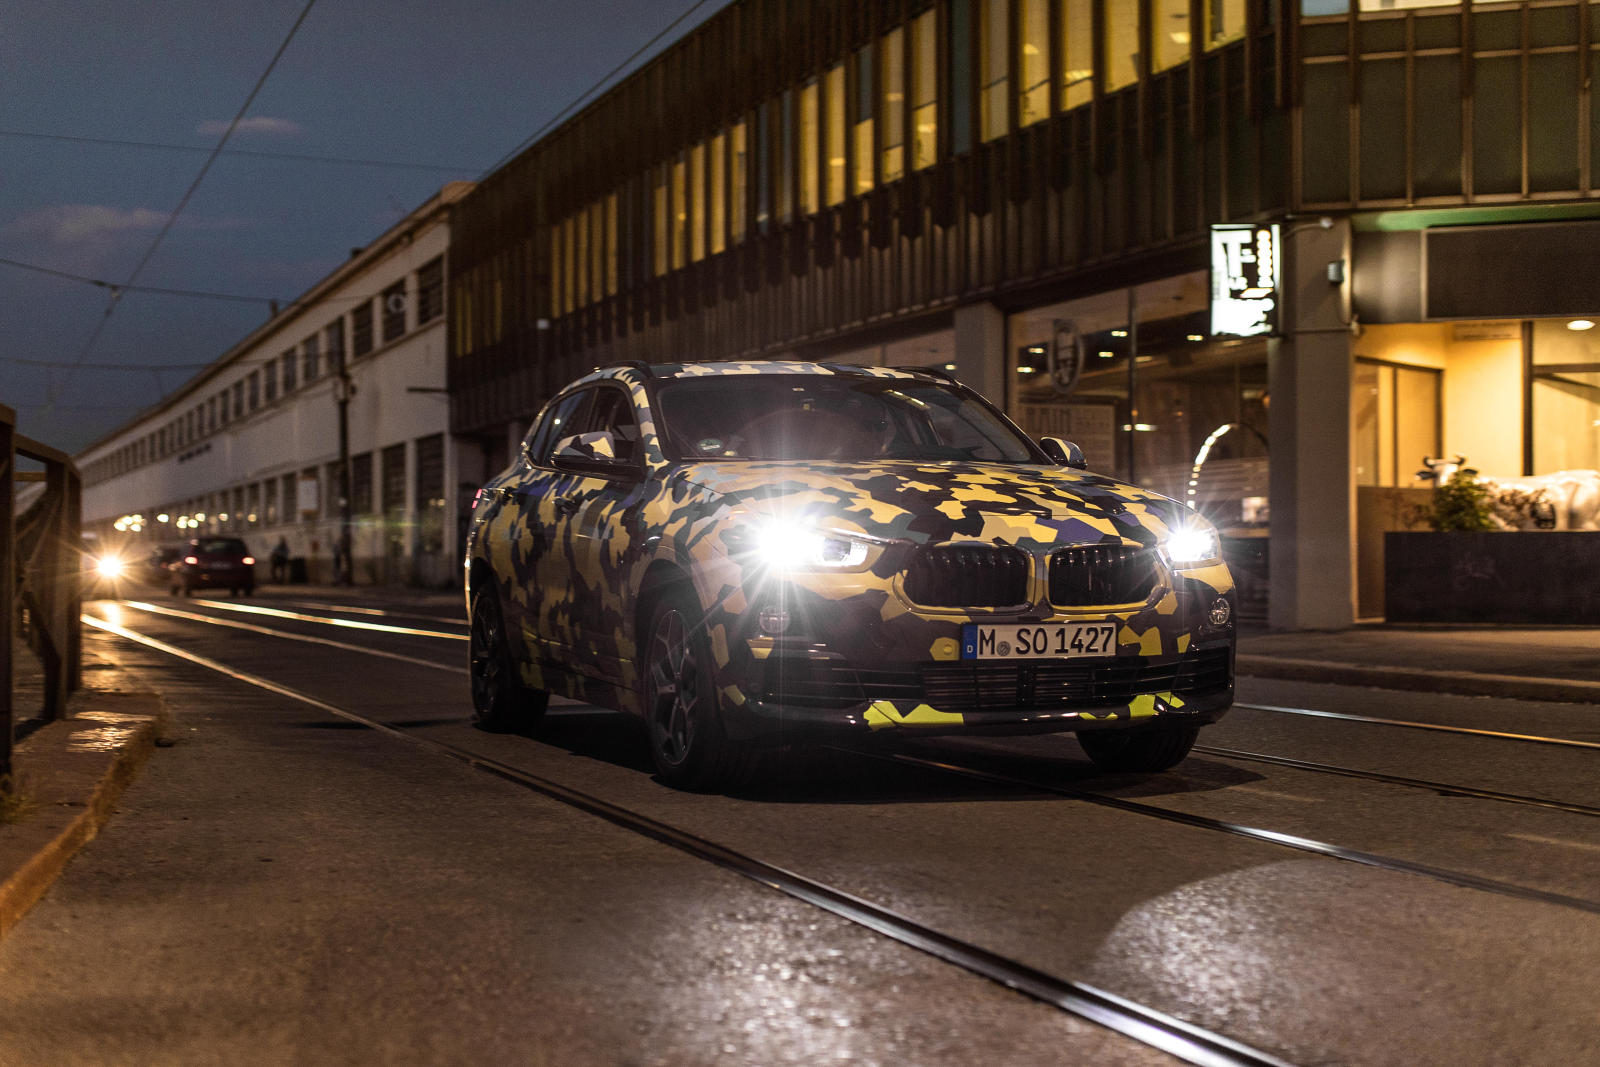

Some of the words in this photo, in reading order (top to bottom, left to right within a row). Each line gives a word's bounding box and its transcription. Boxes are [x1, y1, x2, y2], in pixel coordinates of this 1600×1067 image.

[979, 628, 996, 655] M
[1015, 627, 1048, 655] SO
[1054, 626, 1114, 654] 1427
